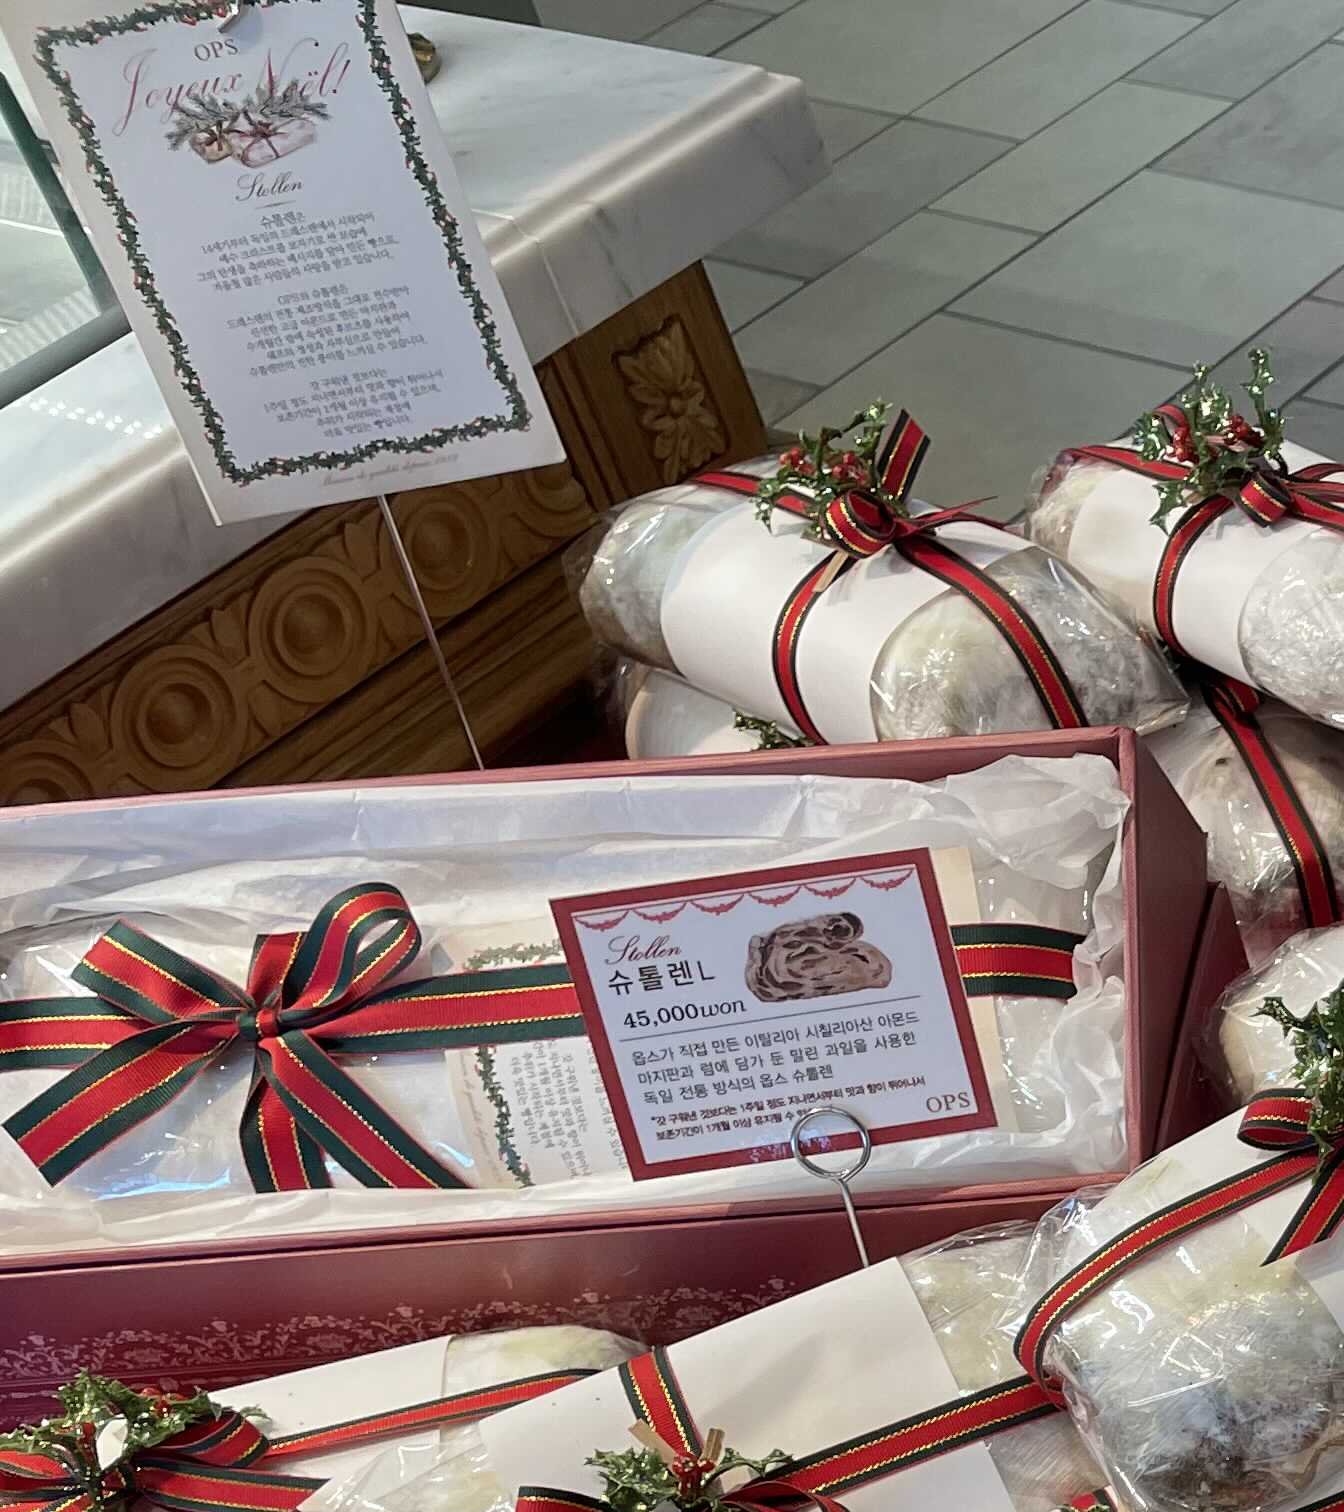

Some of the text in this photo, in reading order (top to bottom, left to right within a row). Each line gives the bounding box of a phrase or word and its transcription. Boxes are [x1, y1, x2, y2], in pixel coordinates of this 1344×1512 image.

[194, 36, 239, 62] OPS
[235, 171, 302, 202] Stollen
[605, 935, 682, 965] Stollen
[608, 960, 715, 995] 슈톨렌L
[624, 1000, 746, 1029] 45,000won
[631, 1011, 920, 1067] 옵스가 직접 만든 이탈리아 시칠리아산 아몬드
[637, 1031, 916, 1085] 마지판과 럼에 담가 둔 말린 과일을 사용한
[643, 1064, 834, 1105] 독일 전통 방식의 옵스 슈톨렌
[925, 1091, 971, 1113] OPS
